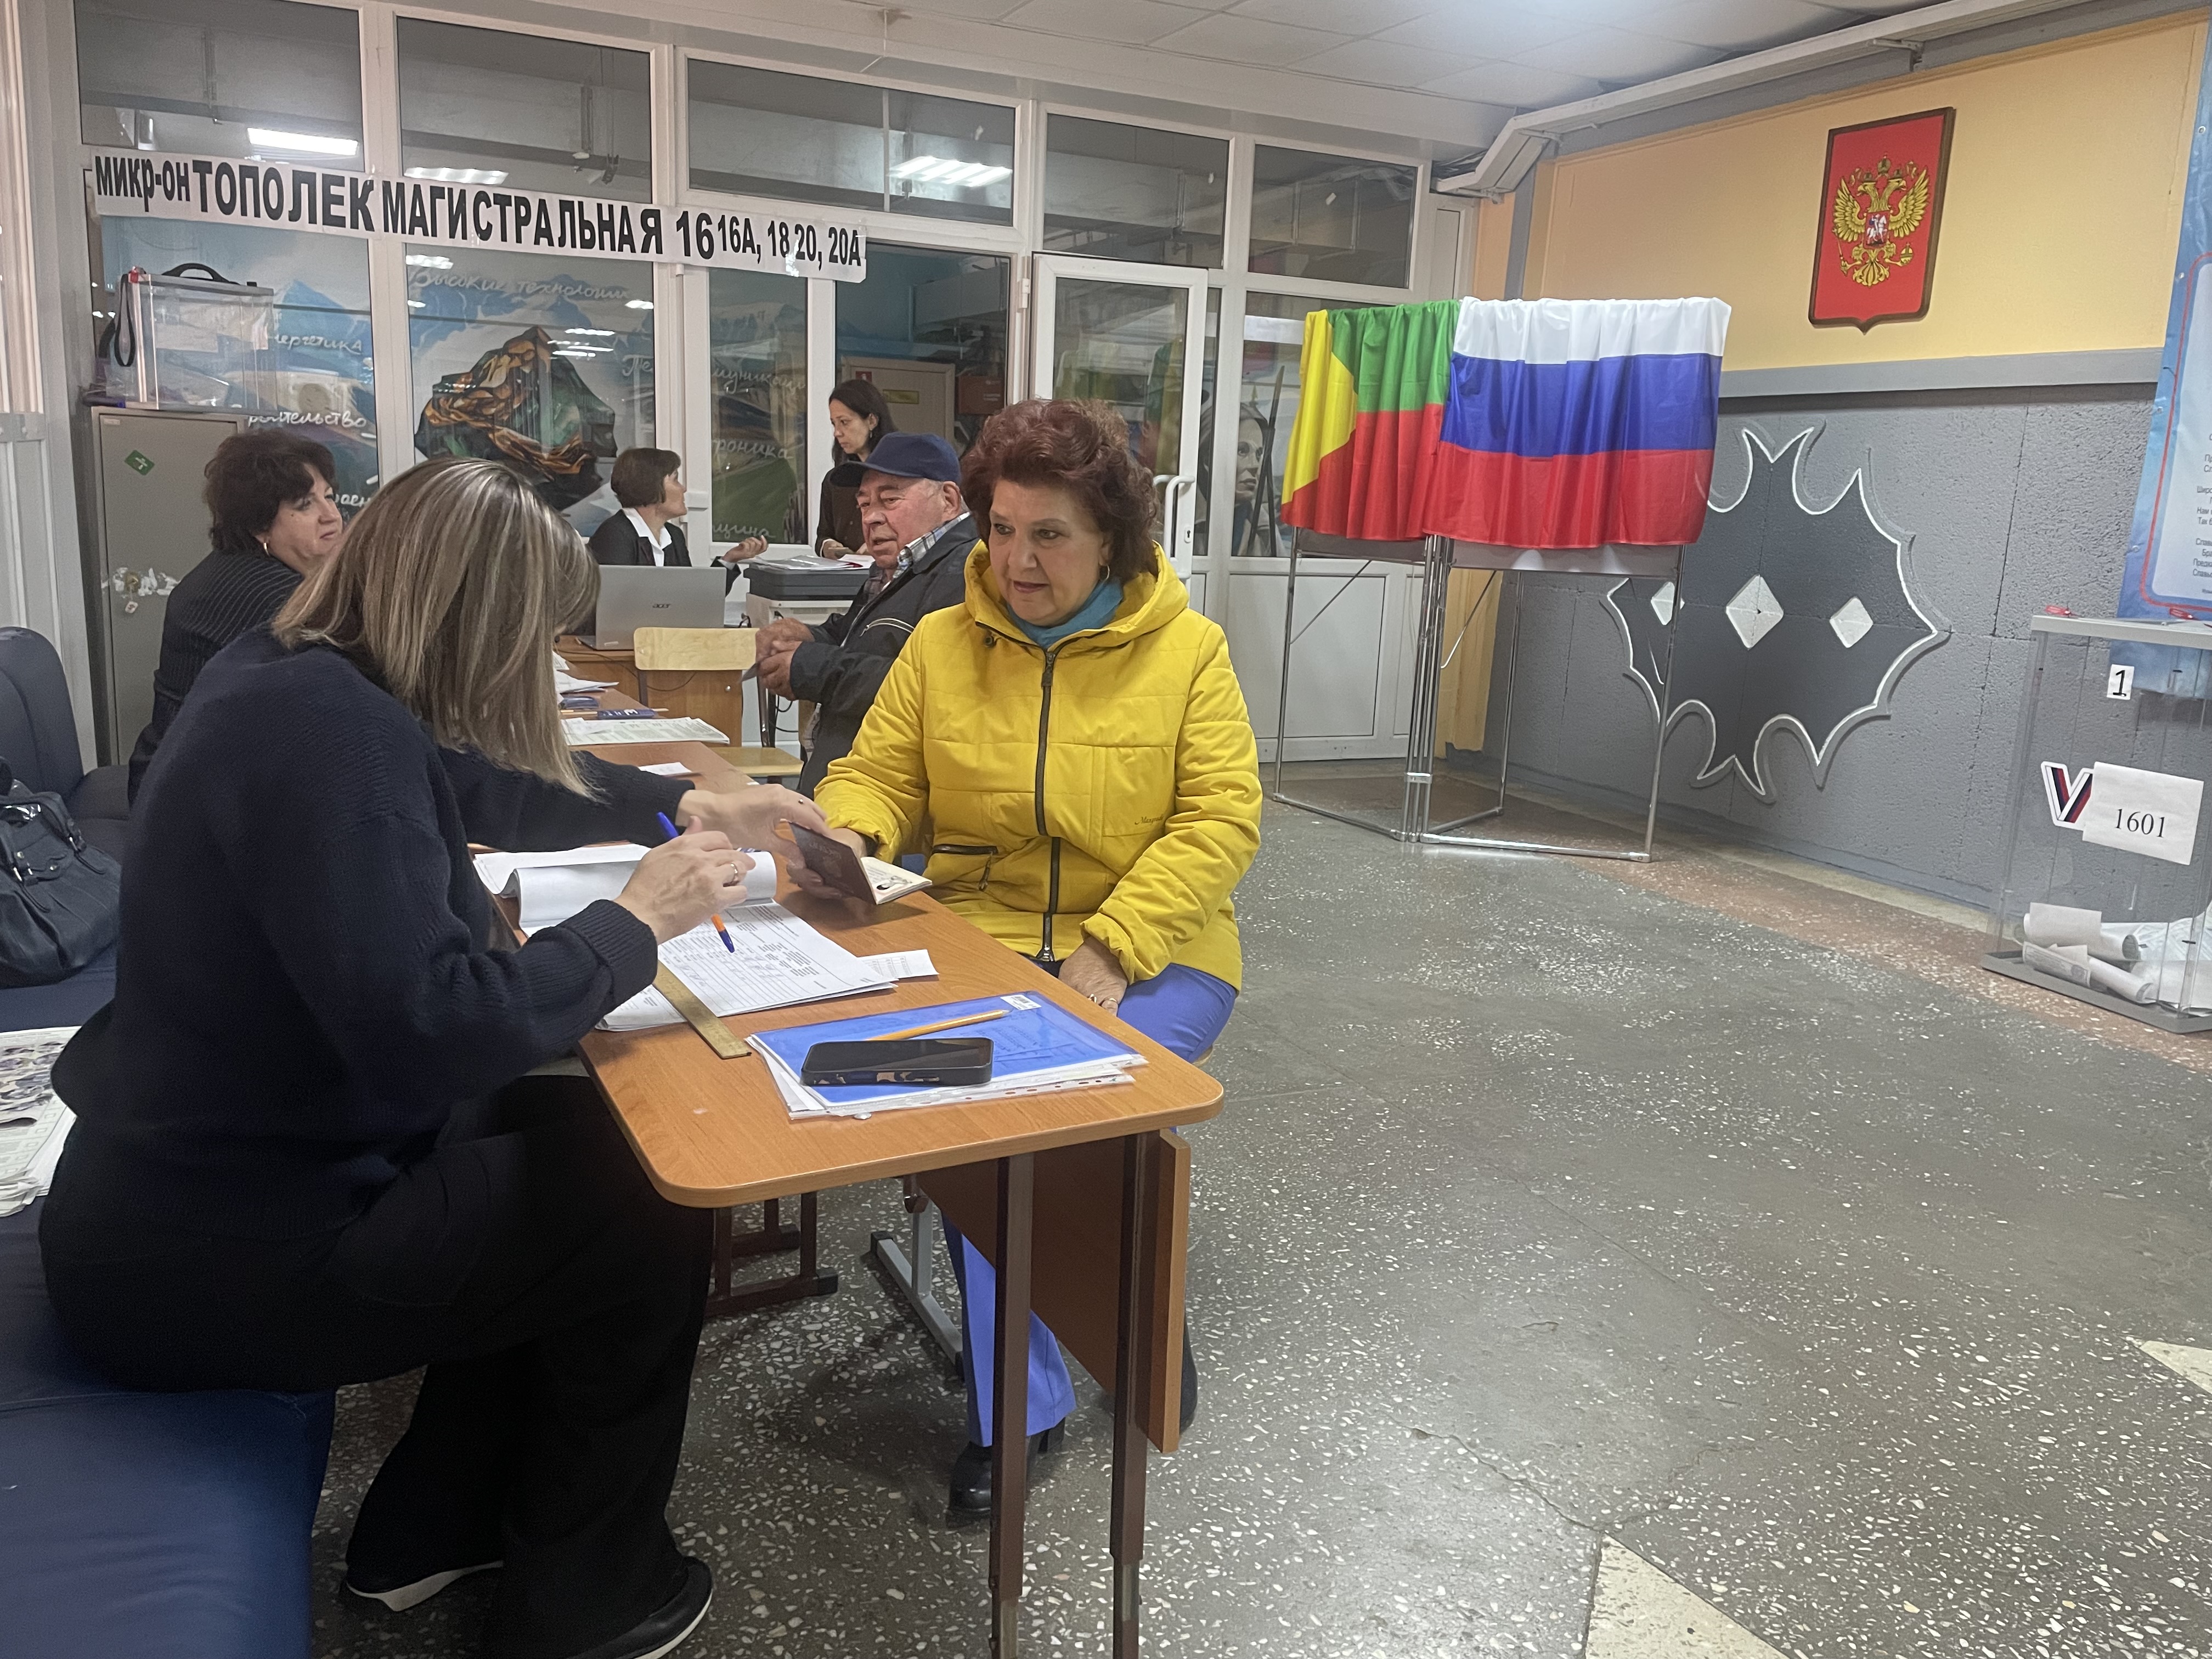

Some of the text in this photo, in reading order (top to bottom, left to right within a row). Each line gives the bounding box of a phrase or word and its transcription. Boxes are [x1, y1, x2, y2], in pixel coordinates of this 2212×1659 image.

[193, 160, 374, 232] ТОПОЛЕК
[382, 180, 663, 255] МАГИСТРАЛЬНАЯ
[676, 211, 714, 259] 16
[718, 215, 761, 264] 16А,
[828, 227, 861, 267] 20А
[2113, 670, 2127, 697] 1
[2115, 808, 2166, 838] 1601
